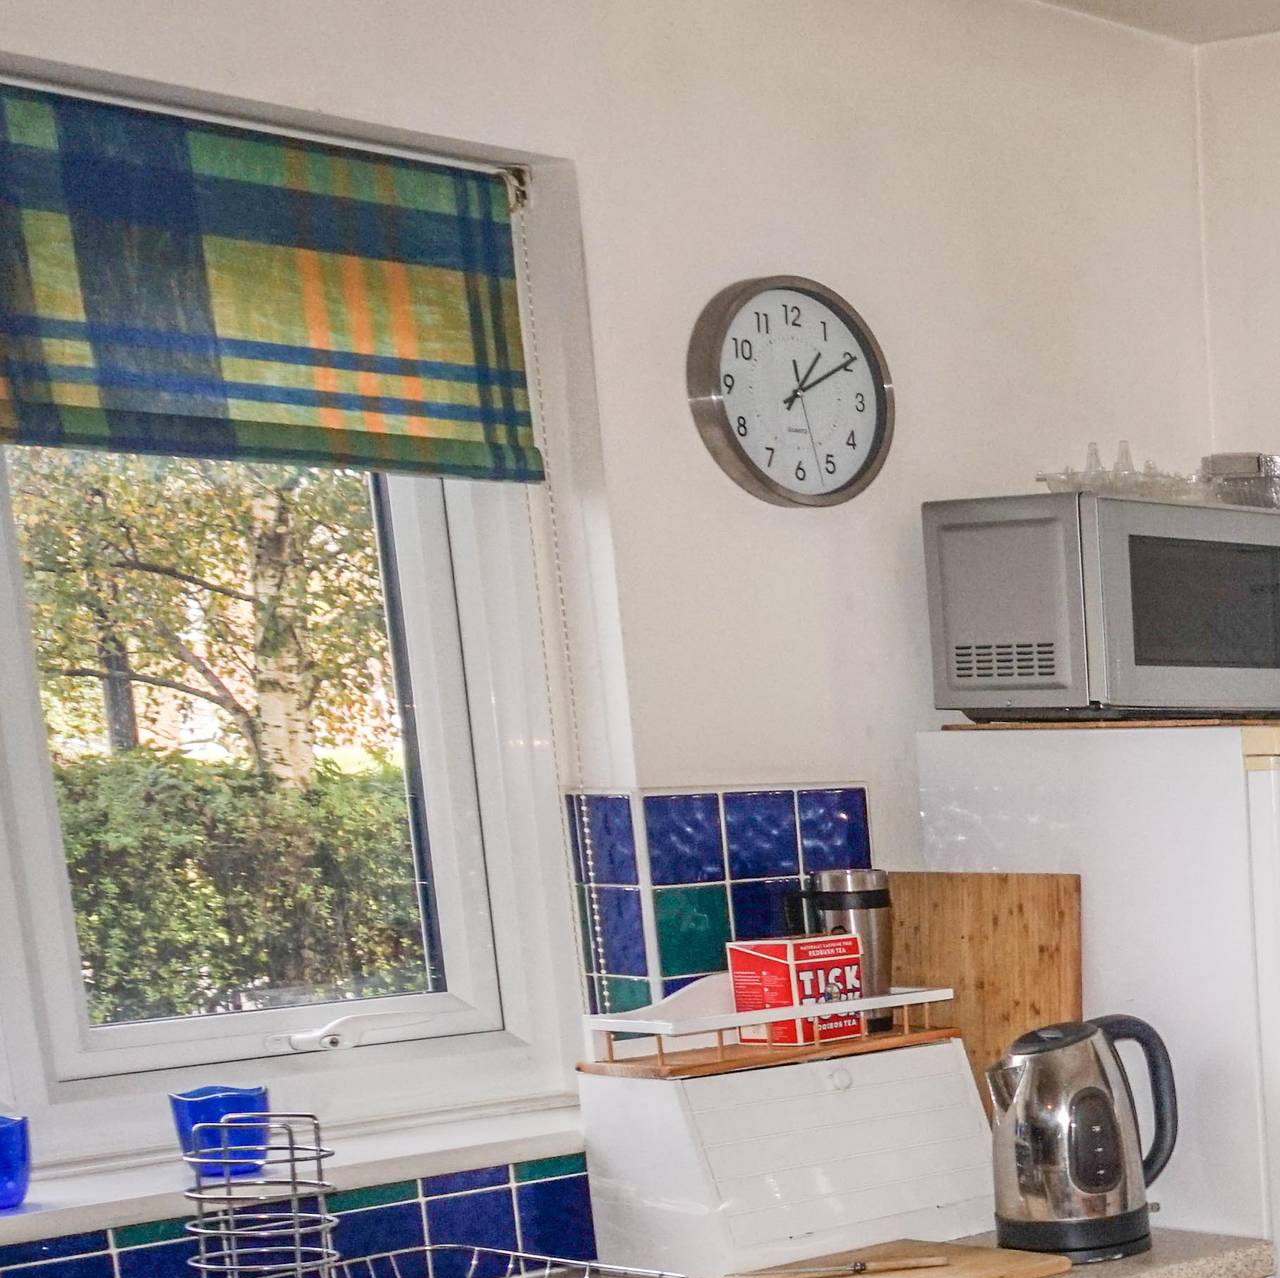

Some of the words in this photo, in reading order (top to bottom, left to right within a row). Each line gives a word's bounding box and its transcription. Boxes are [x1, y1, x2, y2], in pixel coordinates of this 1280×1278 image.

[754, 312, 770, 334] 11
[782, 304, 802, 327] 12
[820, 321, 828, 342] 1
[732, 338, 753, 361] 10
[843, 352, 858, 372] 2
[723, 374, 735, 394] 9
[855, 393, 866, 412] 3
[737, 416, 748, 437] 8
[846, 430, 857, 450] 4
[765, 447, 775, 467] 7
[825, 454, 837, 474] 5
[795, 461, 806, 481] 6
[798, 965, 861, 996] TICK
[844, 1018, 857, 1027] TEA
